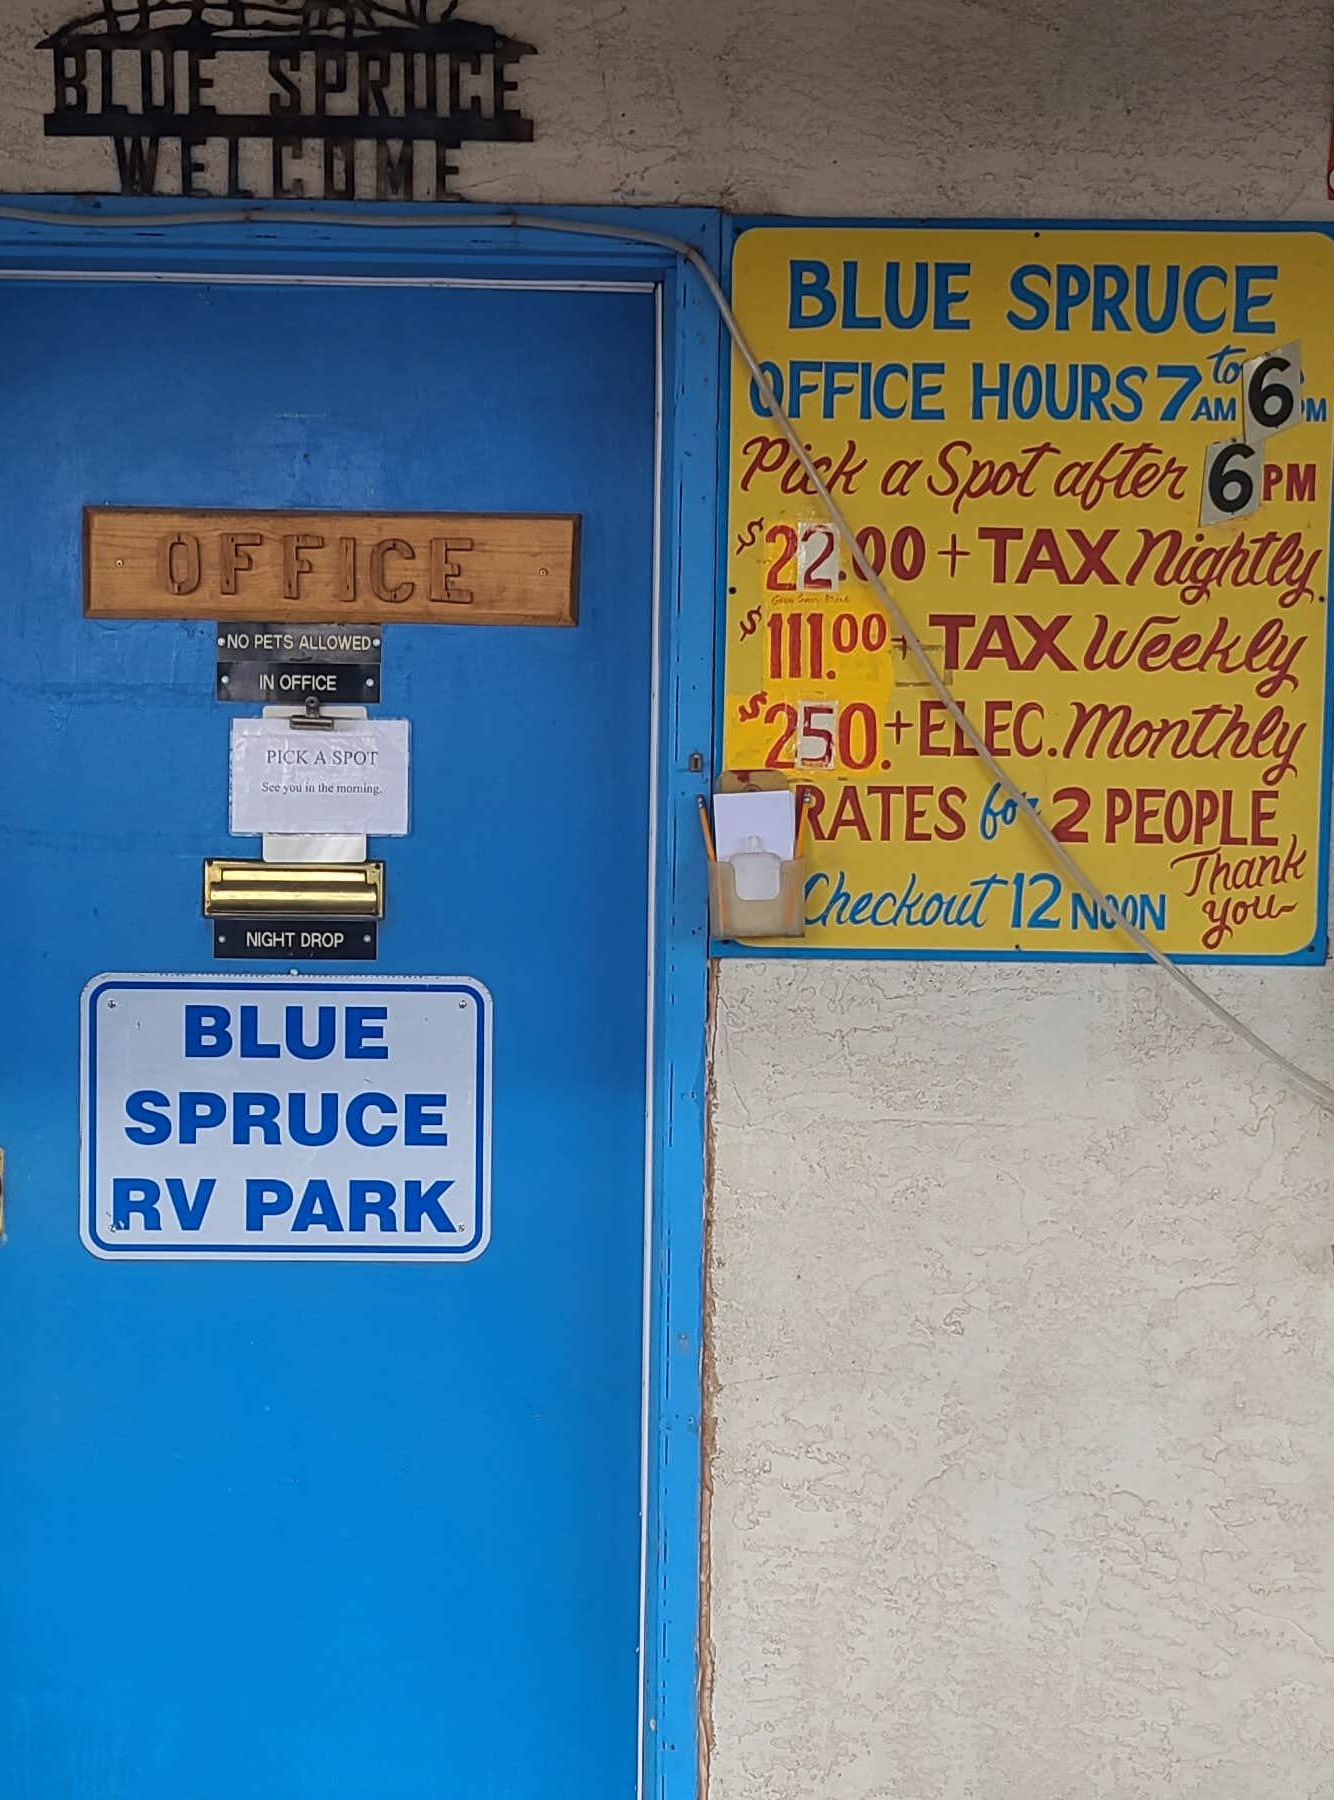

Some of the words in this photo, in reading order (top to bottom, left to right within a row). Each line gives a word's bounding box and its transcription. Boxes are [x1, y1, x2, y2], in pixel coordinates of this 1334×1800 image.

[54, 48, 217, 115] BLUE
[269, 50, 522, 118] SPRUCE
[114, 136, 462, 199] WELCOME
[788, 259, 971, 331] BLUE
[1006, 263, 1279, 334] SPRUCE
[749, 360, 946, 421] OFFICE
[971, 362, 1148, 422] HOURS
[1301, 397, 1327, 422] M
[740, 435, 868, 495] Pick
[880, 458, 923, 498] a
[926, 439, 1062, 515] Spot
[1053, 441, 1189, 512] after
[1208, 443, 1256, 513] 6
[1262, 463, 1317, 502] PM
[162, 531, 474, 604] OFFICE
[977, 526, 1122, 585] TAX
[1125, 528, 1323, 609] Nightly
[227, 634, 249, 649] NO
[254, 634, 294, 649] PETS
[299, 635, 371, 650] ALLOWED
[928, 614, 1079, 672] TAX
[1083, 614, 1308, 699] Weekly
[259, 674, 275, 690] IN
[279, 674, 337, 691] OFFICE
[266, 749, 309, 765] PICK
[313, 750, 327, 765] A
[332, 750, 379, 766] SPOT
[1062, 701, 1308, 786] Monthly
[261, 782, 281, 793] See
[283, 784, 302, 795] you
[305, 783, 315, 793] in
[318, 783, 334, 793] the
[336, 783, 382, 796] morning.
[795, 784, 967, 842] RATES
[1050, 786, 1091, 843] 2
[1104, 788, 1280, 846] PEOPLE
[1170, 833, 1307, 897] Thank
[804, 870, 1009, 928] Checkout
[1010, 872, 1062, 928] 12
[1071, 893, 1167, 931] NOON
[246, 932, 295, 947] NIGHT
[301, 932, 344, 948] DROP
[184, 1004, 390, 1060] BLUE
[123, 1090, 449, 1147] SPRUCE
[112, 1177, 217, 1232] RV
[244, 1178, 458, 1234] PARK
